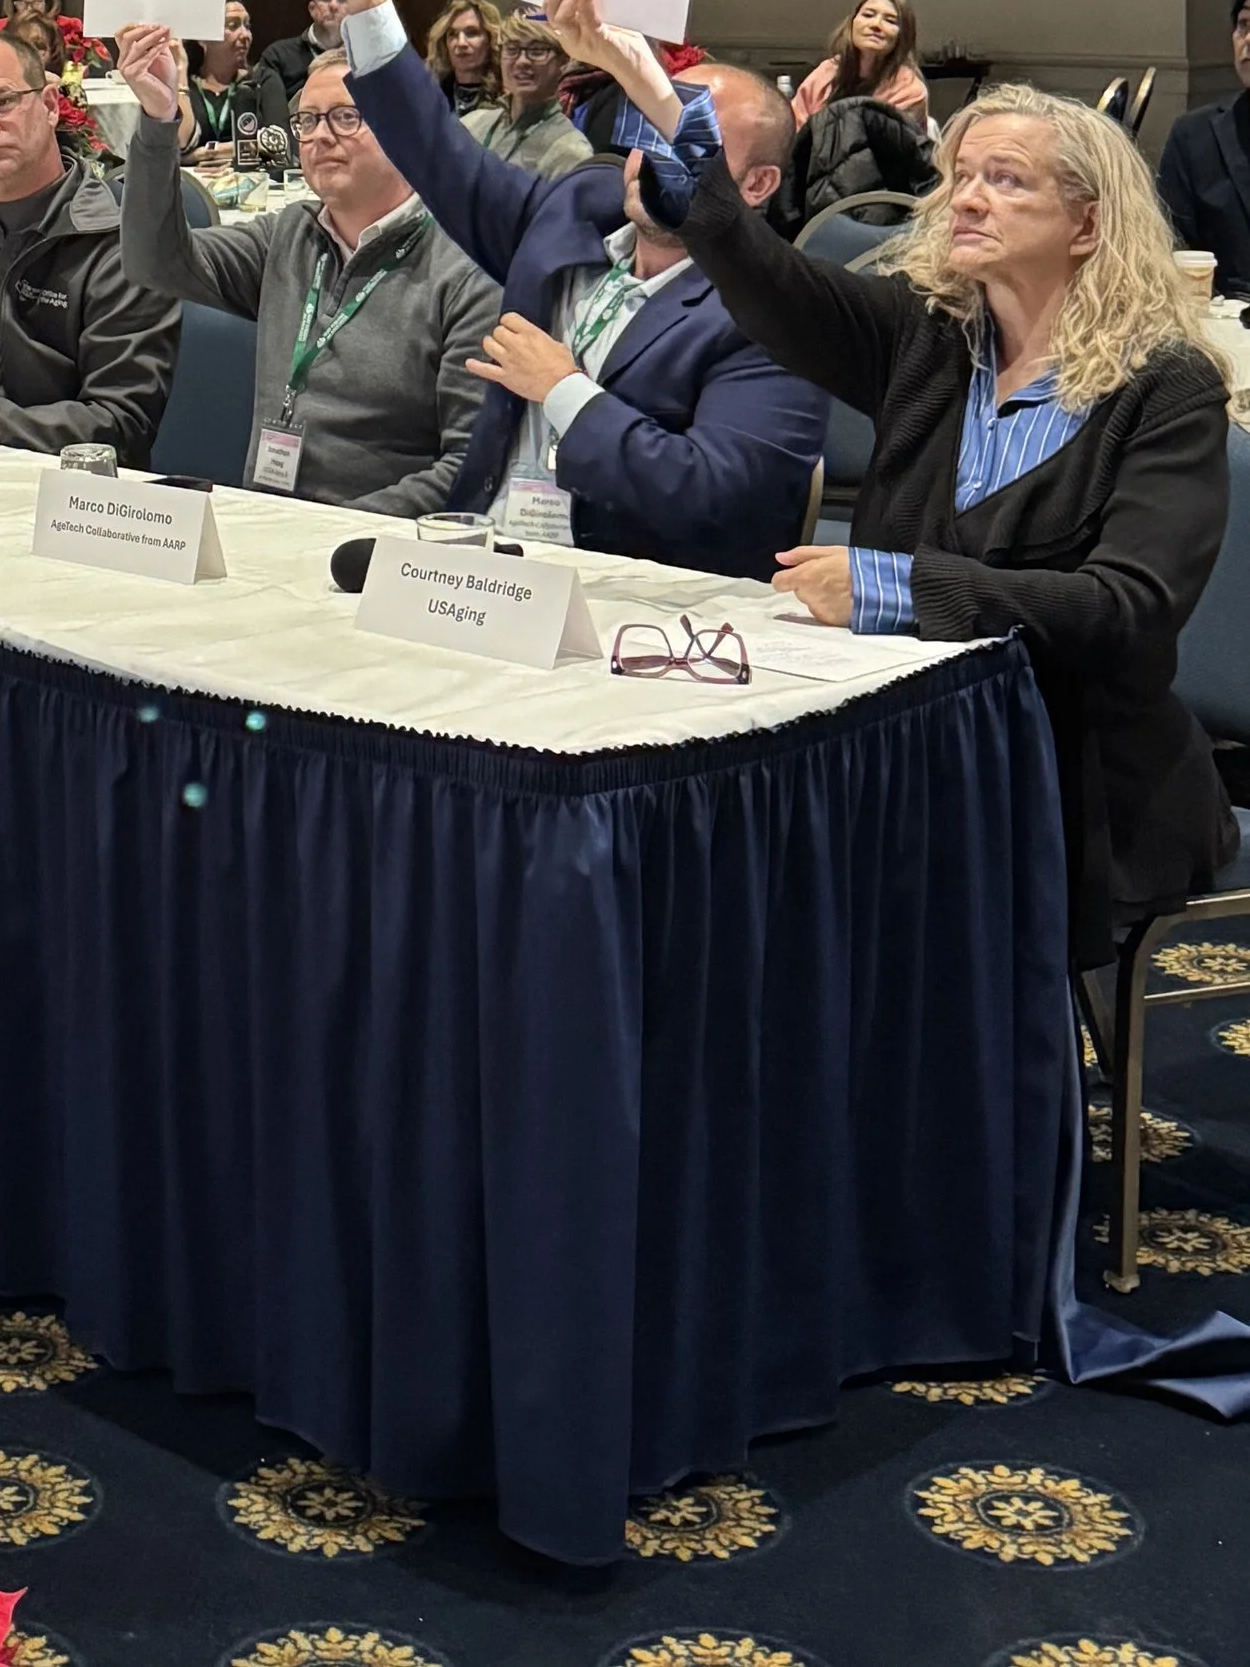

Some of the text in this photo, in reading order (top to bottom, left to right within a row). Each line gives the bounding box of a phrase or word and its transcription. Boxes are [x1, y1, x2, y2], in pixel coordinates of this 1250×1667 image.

[69, 496, 172, 525] Marco DiGirolomo
[51, 519, 186, 551] AgeTech Collaborative from AARP
[400, 562, 532, 602] Courtney Baldridge
[428, 599, 486, 626] USAging
